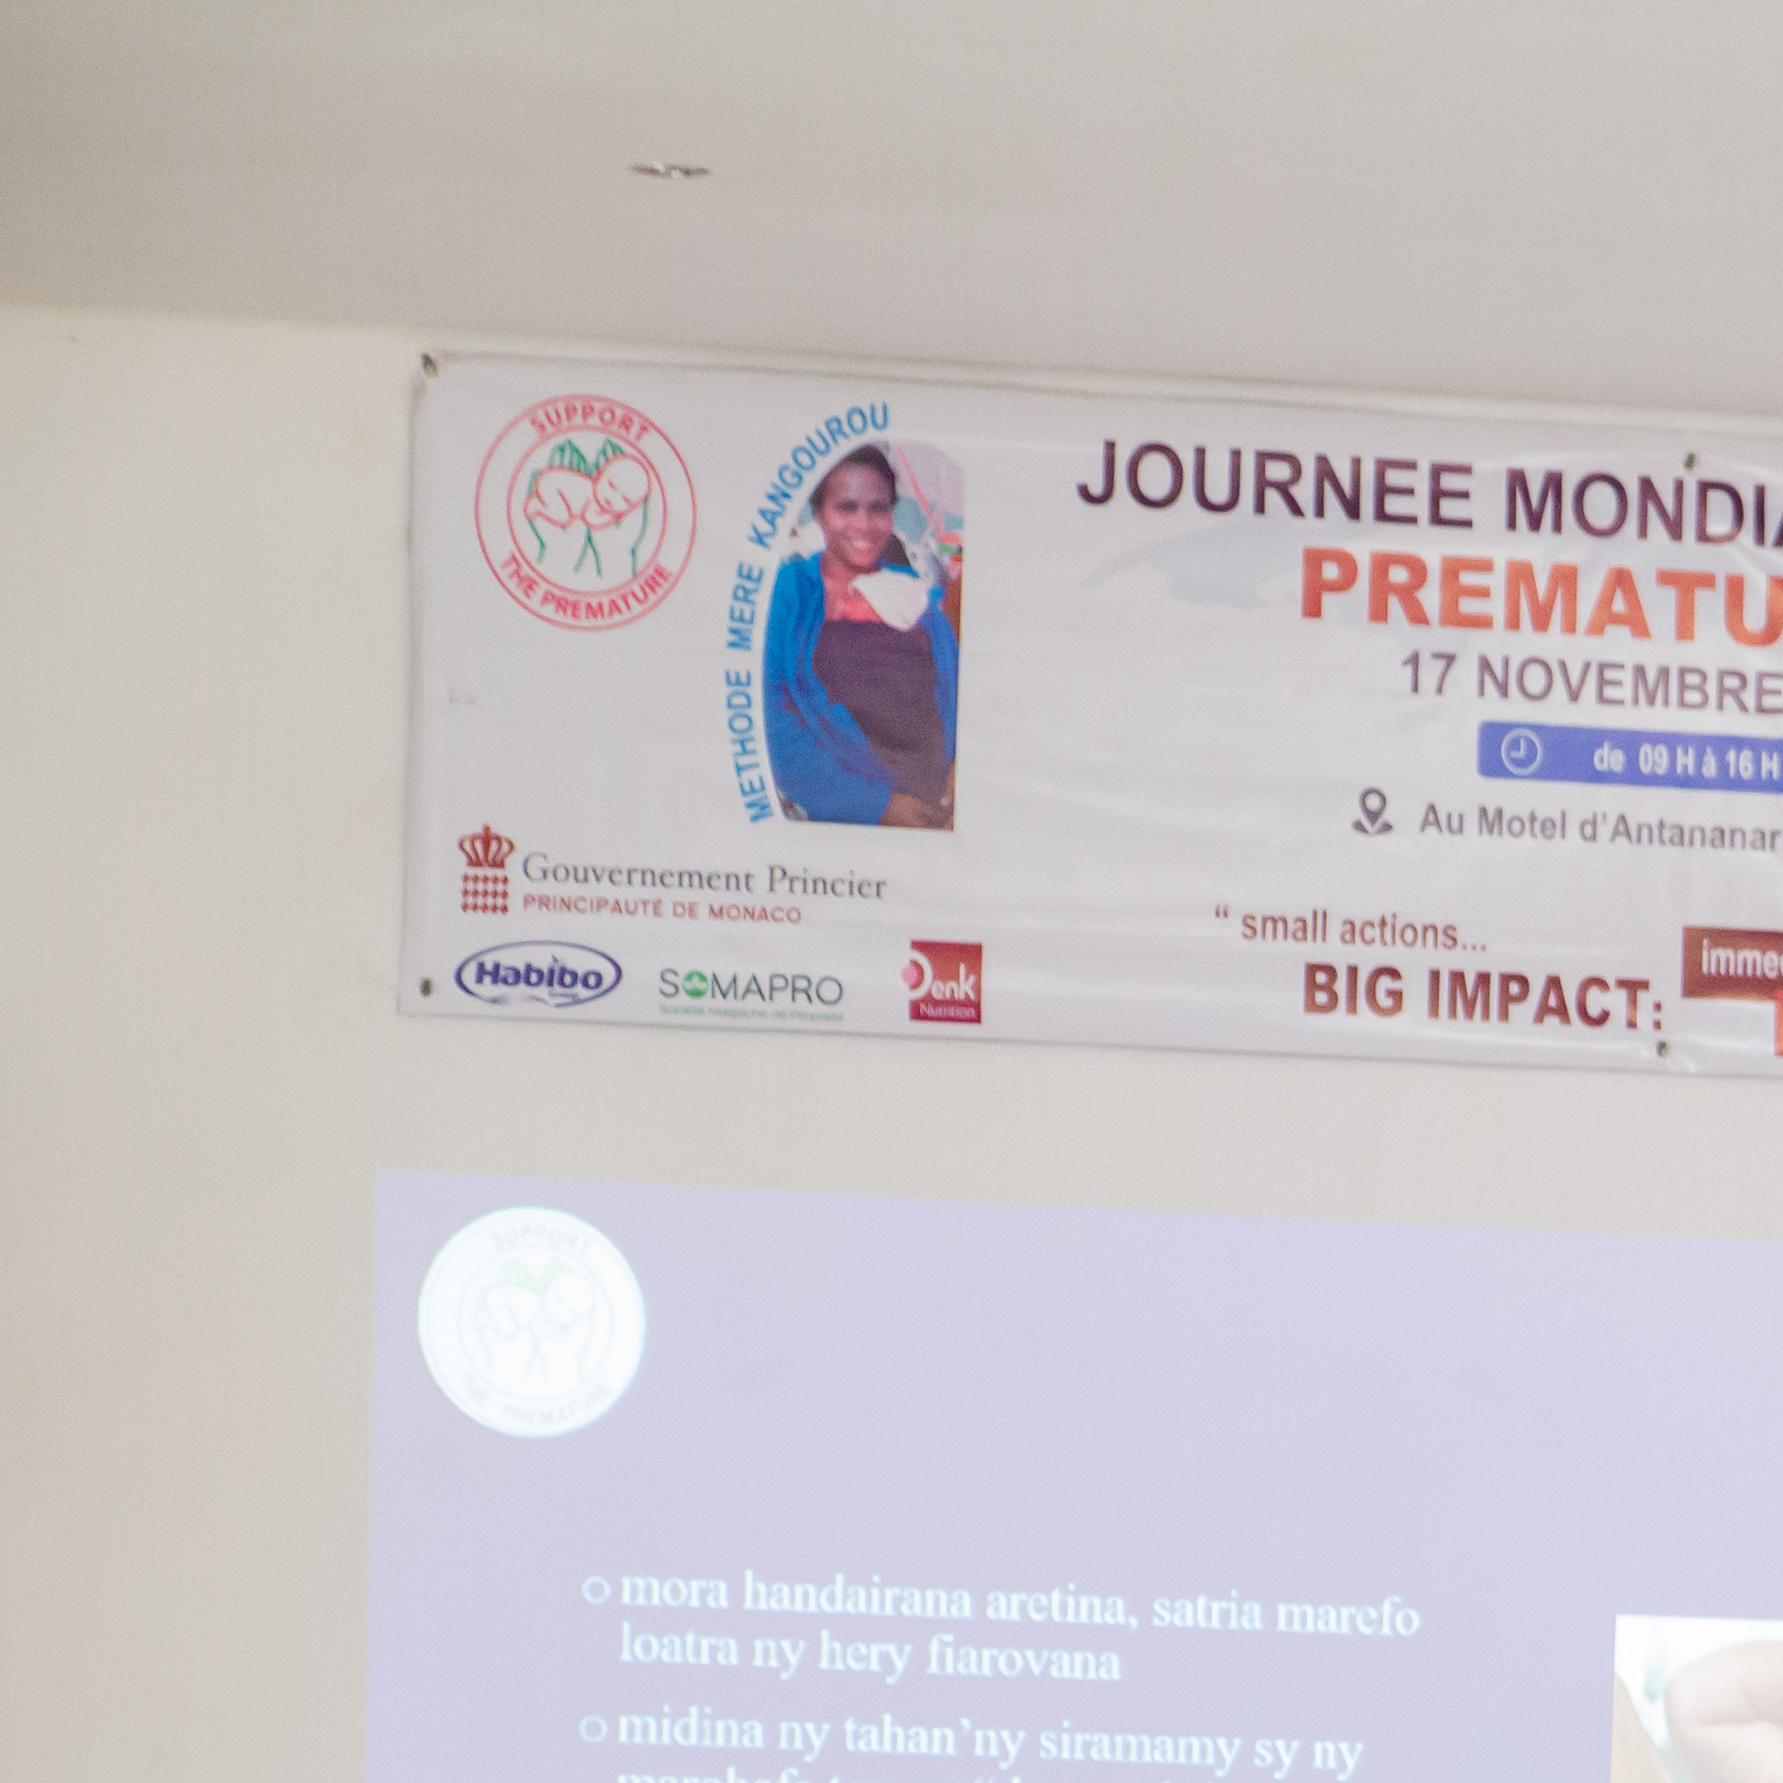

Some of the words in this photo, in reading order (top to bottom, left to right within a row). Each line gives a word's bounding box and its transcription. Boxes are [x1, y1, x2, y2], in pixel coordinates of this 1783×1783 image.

[529, 402, 650, 442] SUPPORT
[747, 401, 889, 550] KANGOUROU
[1076, 439, 1474, 529] JOURNEE
[501, 551, 539, 600] THE
[541, 563, 673, 620] PREMATURE
[726, 560, 764, 652] MERE
[1402, 650, 1457, 696] 17
[725, 669, 774, 824] METHODE
[1593, 741, 1625, 774] de
[1639, 746, 1668, 776] 09
[1676, 744, 1695, 776] H
[1702, 745, 1717, 779] à
[1725, 749, 1754, 780] 16
[1761, 750, 1782, 781] H
[1420, 803, 1464, 836] Au
[1479, 806, 1567, 841] Motel
[521, 852, 755, 893] Gouvernement
[767, 864, 888, 900] Princier
[523, 892, 663, 918] PRINCIPAUTÉ
[672, 901, 699, 920] DE
[708, 903, 802, 924] MONACO
[1340, 912, 1487, 952] actions...
[474, 954, 604, 990] Habibo
[659, 968, 844, 1006] SOMAPRO
[1303, 962, 1404, 1017] BIG
[1428, 969, 1663, 1031] IMPACT:
[620, 1575, 729, 1610] mora
[743, 1568, 973, 1619] handairana
[986, 1582, 1140, 1633] aretina,
[1152, 1589, 1264, 1631] satria
[1276, 1595, 1422, 1637] marefo
[619, 1620, 740, 1666] loatra
[752, 1636, 807, 1681] ny
[818, 1630, 913, 1685] hery
[926, 1633, 1122, 1681] fiarovana
[618, 1704, 765, 1749] midina
[778, 1719, 832, 1763] ny
[1040, 1720, 1242, 1777] siramamy
[1254, 1738, 1300, 1779] sy
[1313, 1740, 1364, 1782] ny
